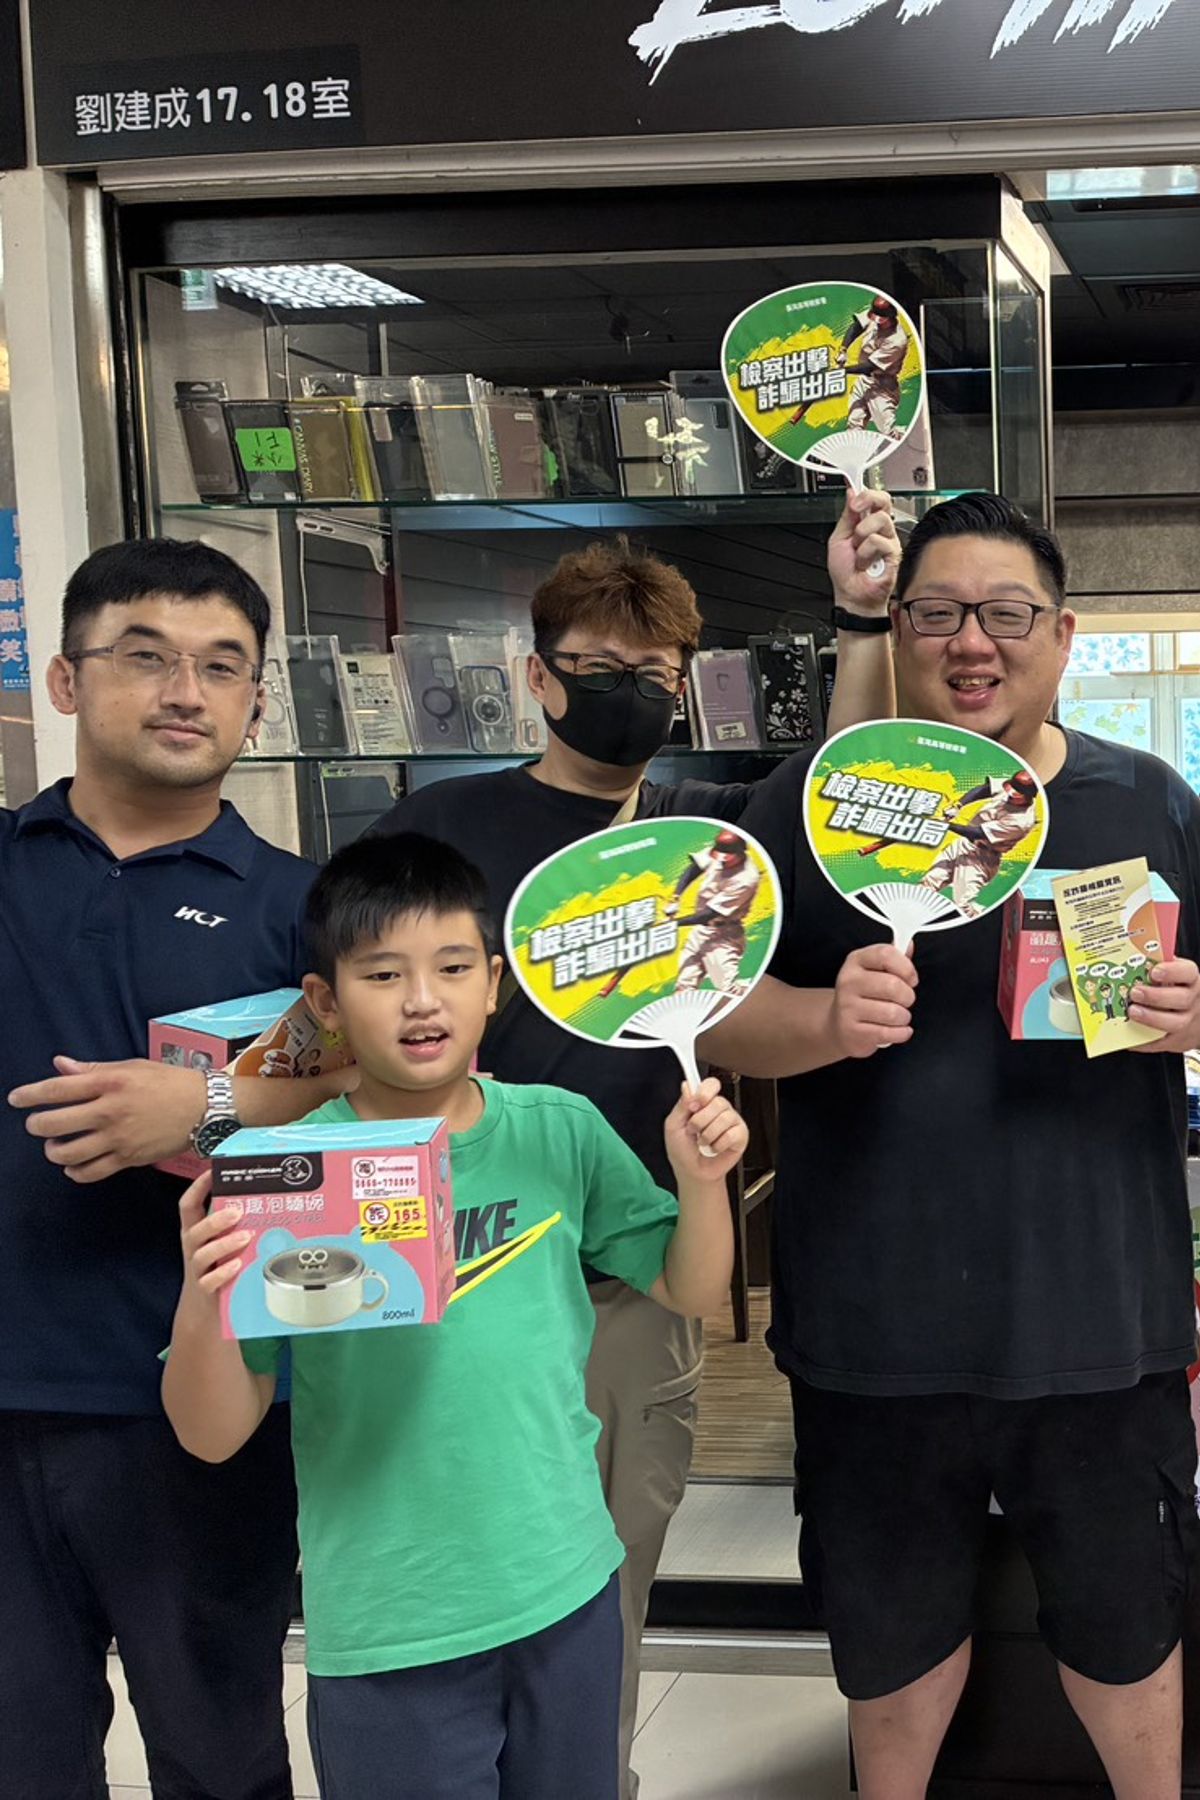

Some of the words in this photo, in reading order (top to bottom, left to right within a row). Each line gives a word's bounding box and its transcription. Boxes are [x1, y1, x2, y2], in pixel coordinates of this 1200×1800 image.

[740, 347, 829, 388] 檢察出擊
[757, 369, 847, 410] 詐騙出局
[822, 772, 943, 816] 檢察出擊
[828, 801, 950, 847] 詐騙出局
[530, 897, 657, 962] 檢察出擊
[554, 921, 679, 988] 詐騙出局
[394, 1209, 420, 1223] 165
[453, 1199, 518, 1261] IKE
